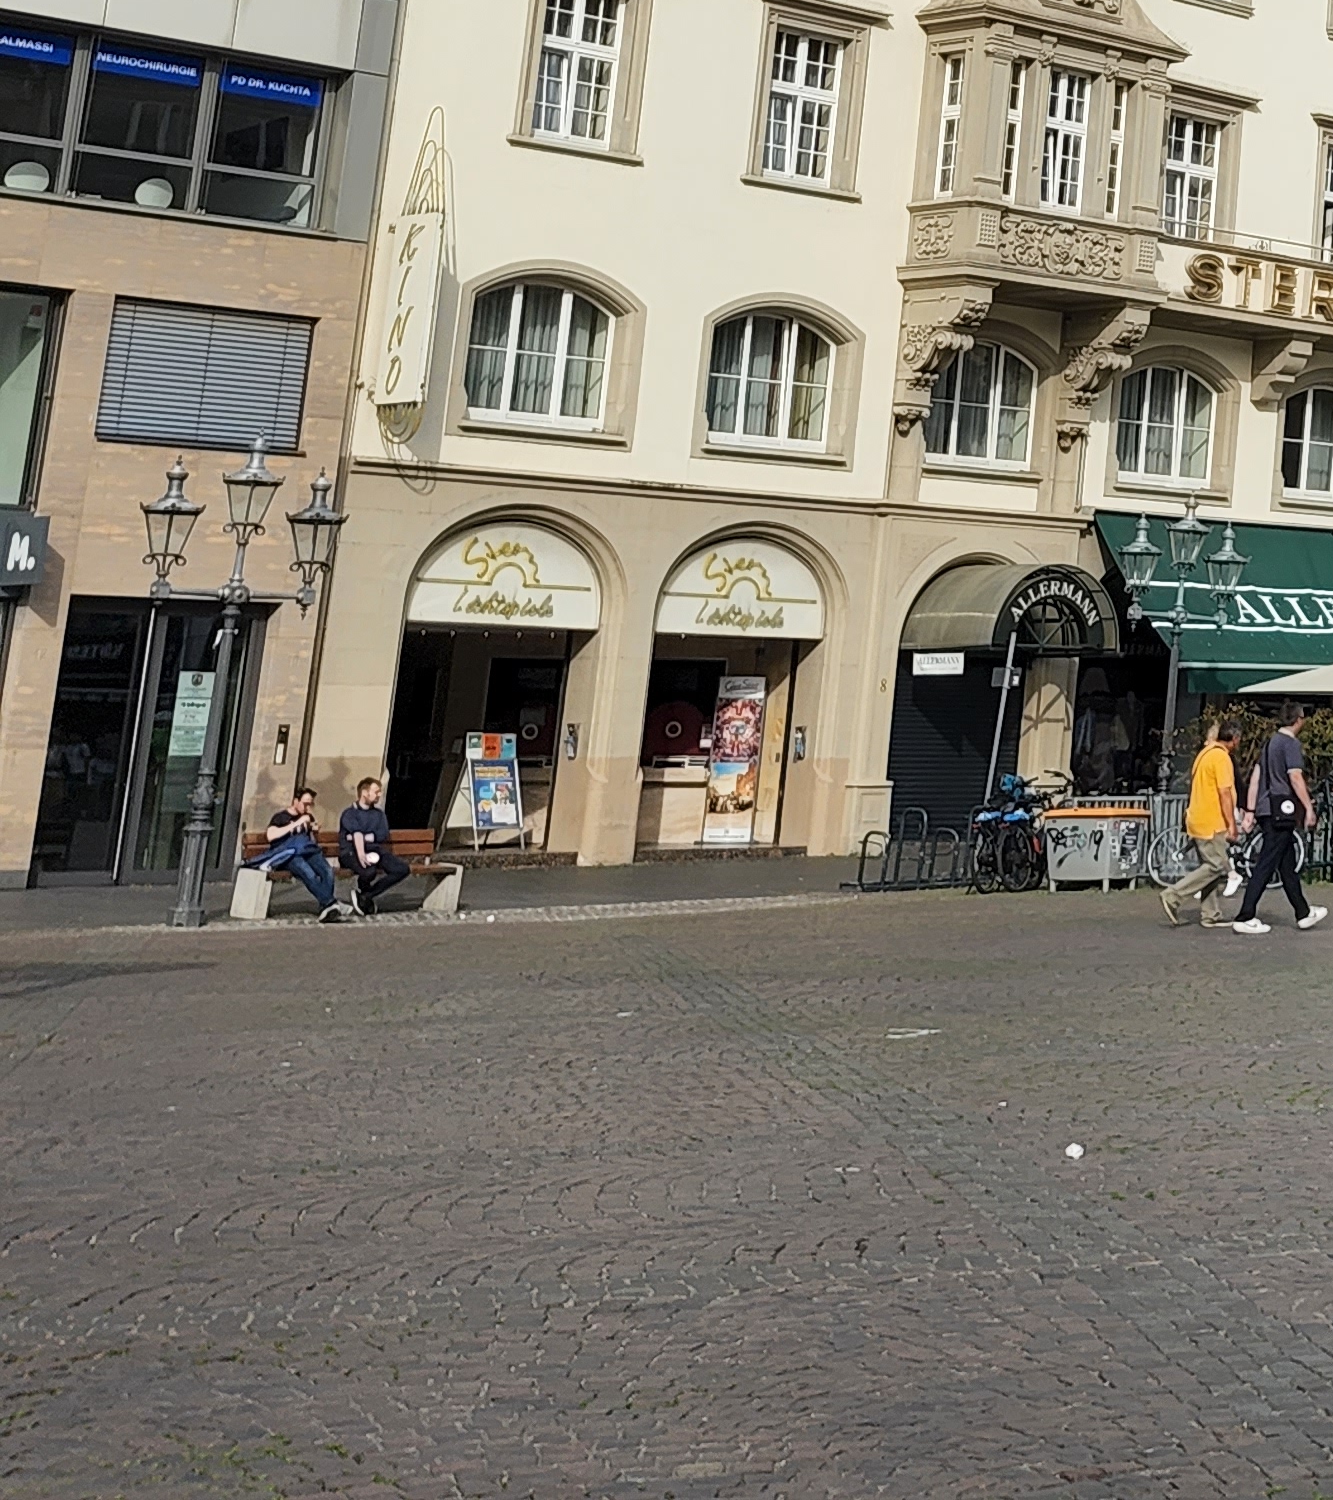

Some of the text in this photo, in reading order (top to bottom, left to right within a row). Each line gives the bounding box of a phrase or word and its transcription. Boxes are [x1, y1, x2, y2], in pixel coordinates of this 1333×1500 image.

[0, 35, 54, 53] ALMASSI
[96, 52, 197, 77] NEUROCHIRURGIE
[231, 74, 311, 97] PD DR. KUCHTA
[385, 223, 426, 396] KINO
[1010, 580, 1100, 627] ALLERMANN
[880, 678, 887, 693] 8
